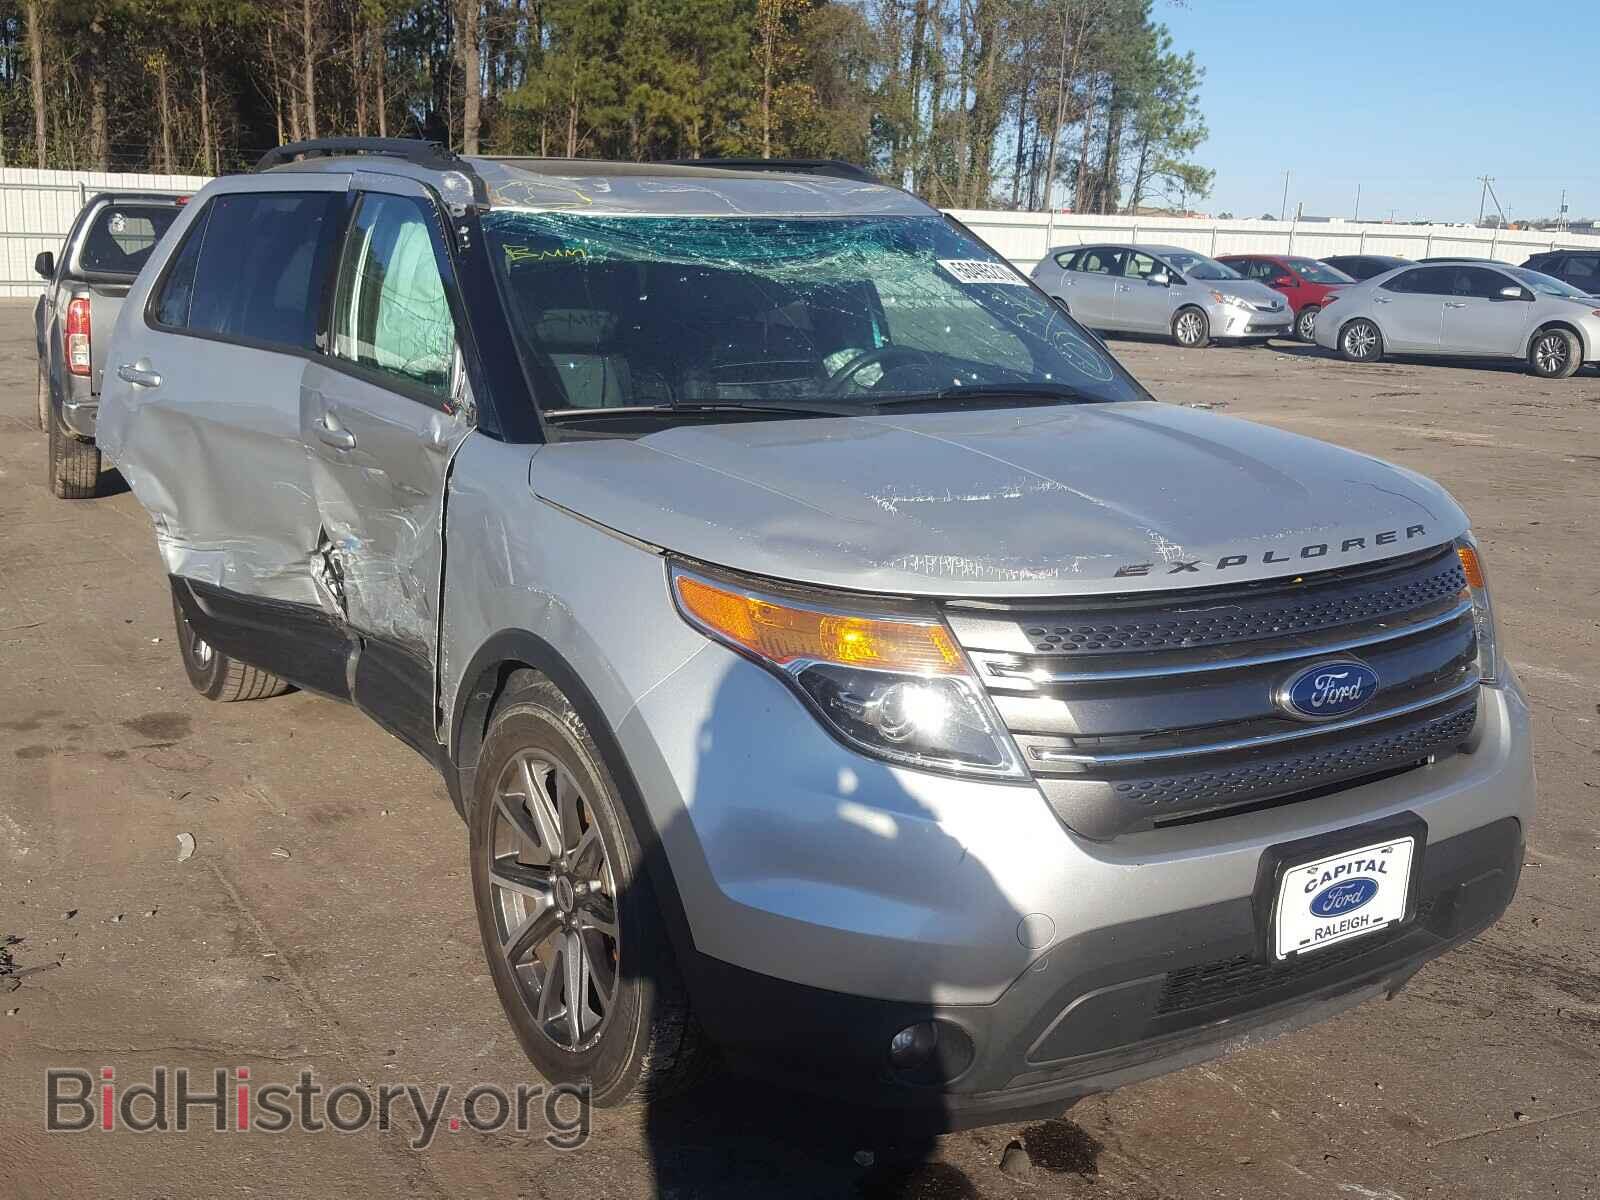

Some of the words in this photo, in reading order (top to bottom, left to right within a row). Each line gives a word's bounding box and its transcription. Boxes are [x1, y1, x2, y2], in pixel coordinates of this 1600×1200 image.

[1114, 524, 1426, 577] EXPLORER
[1311, 672, 1362, 707] Ford
[1304, 859, 1388, 893] CAPITAL
[1322, 883, 1365, 911] Ford
[1314, 914, 1370, 940] RALEIGH
